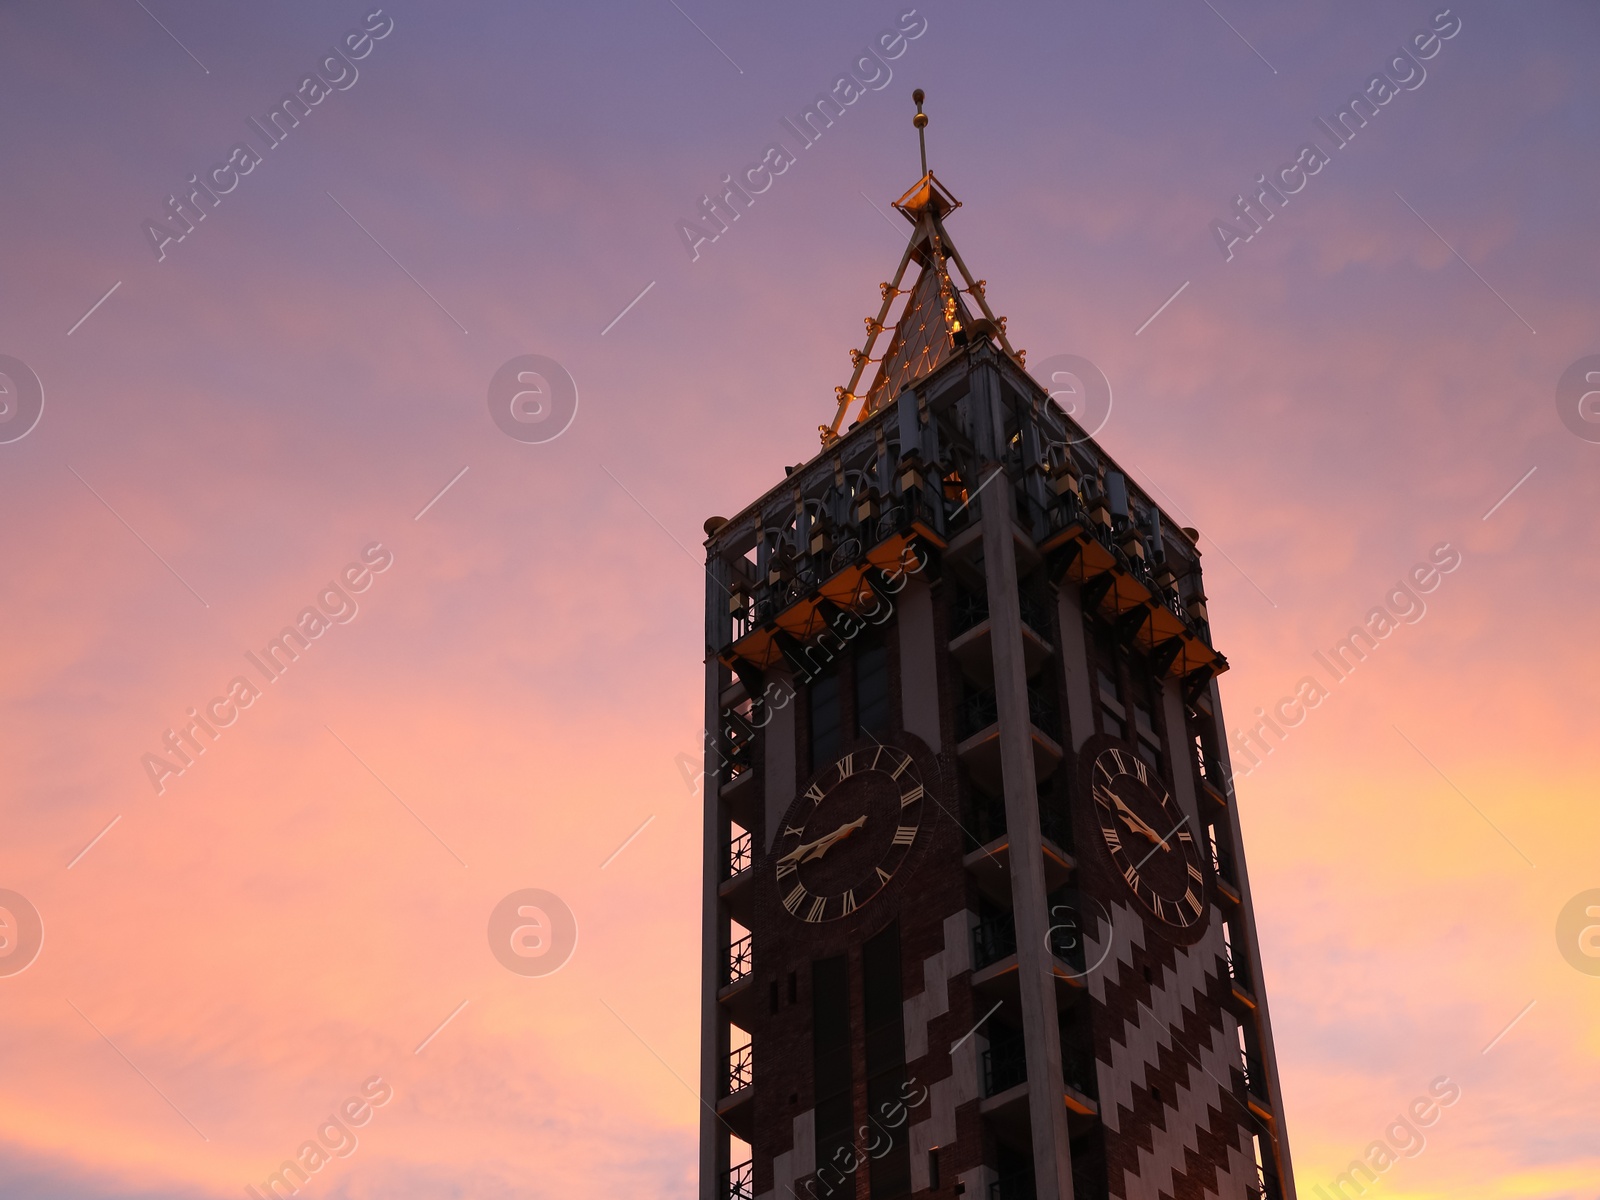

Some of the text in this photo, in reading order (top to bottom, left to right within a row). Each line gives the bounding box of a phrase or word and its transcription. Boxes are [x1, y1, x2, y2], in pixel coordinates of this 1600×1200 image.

[836, 752, 854, 782] XII
[870, 745, 884, 770] I
[891, 754, 913, 782] II
[1095, 757, 1113, 784] X
[1109, 748, 1127, 774] XI
[1132, 756, 1148, 787] XII
[804, 783, 826, 806] XI
[900, 784, 923, 809] III
[1161, 791, 1170, 808] I
[783, 825, 805, 837] X
[892, 825, 919, 846] IIII
[1102, 828, 1122, 855] VIII
[1177, 831, 1193, 841] II
[875, 867, 893, 885] V
[1124, 863, 1139, 894] VII
[1186, 862, 1203, 885] III
[782, 882, 807, 915] VIII
[805, 896, 827, 923] VII
[841, 889, 858, 917] VI
[1152, 891, 1165, 921] VI
[1184, 886, 1202, 917] IIII
[1175, 901, 1188, 927] V
